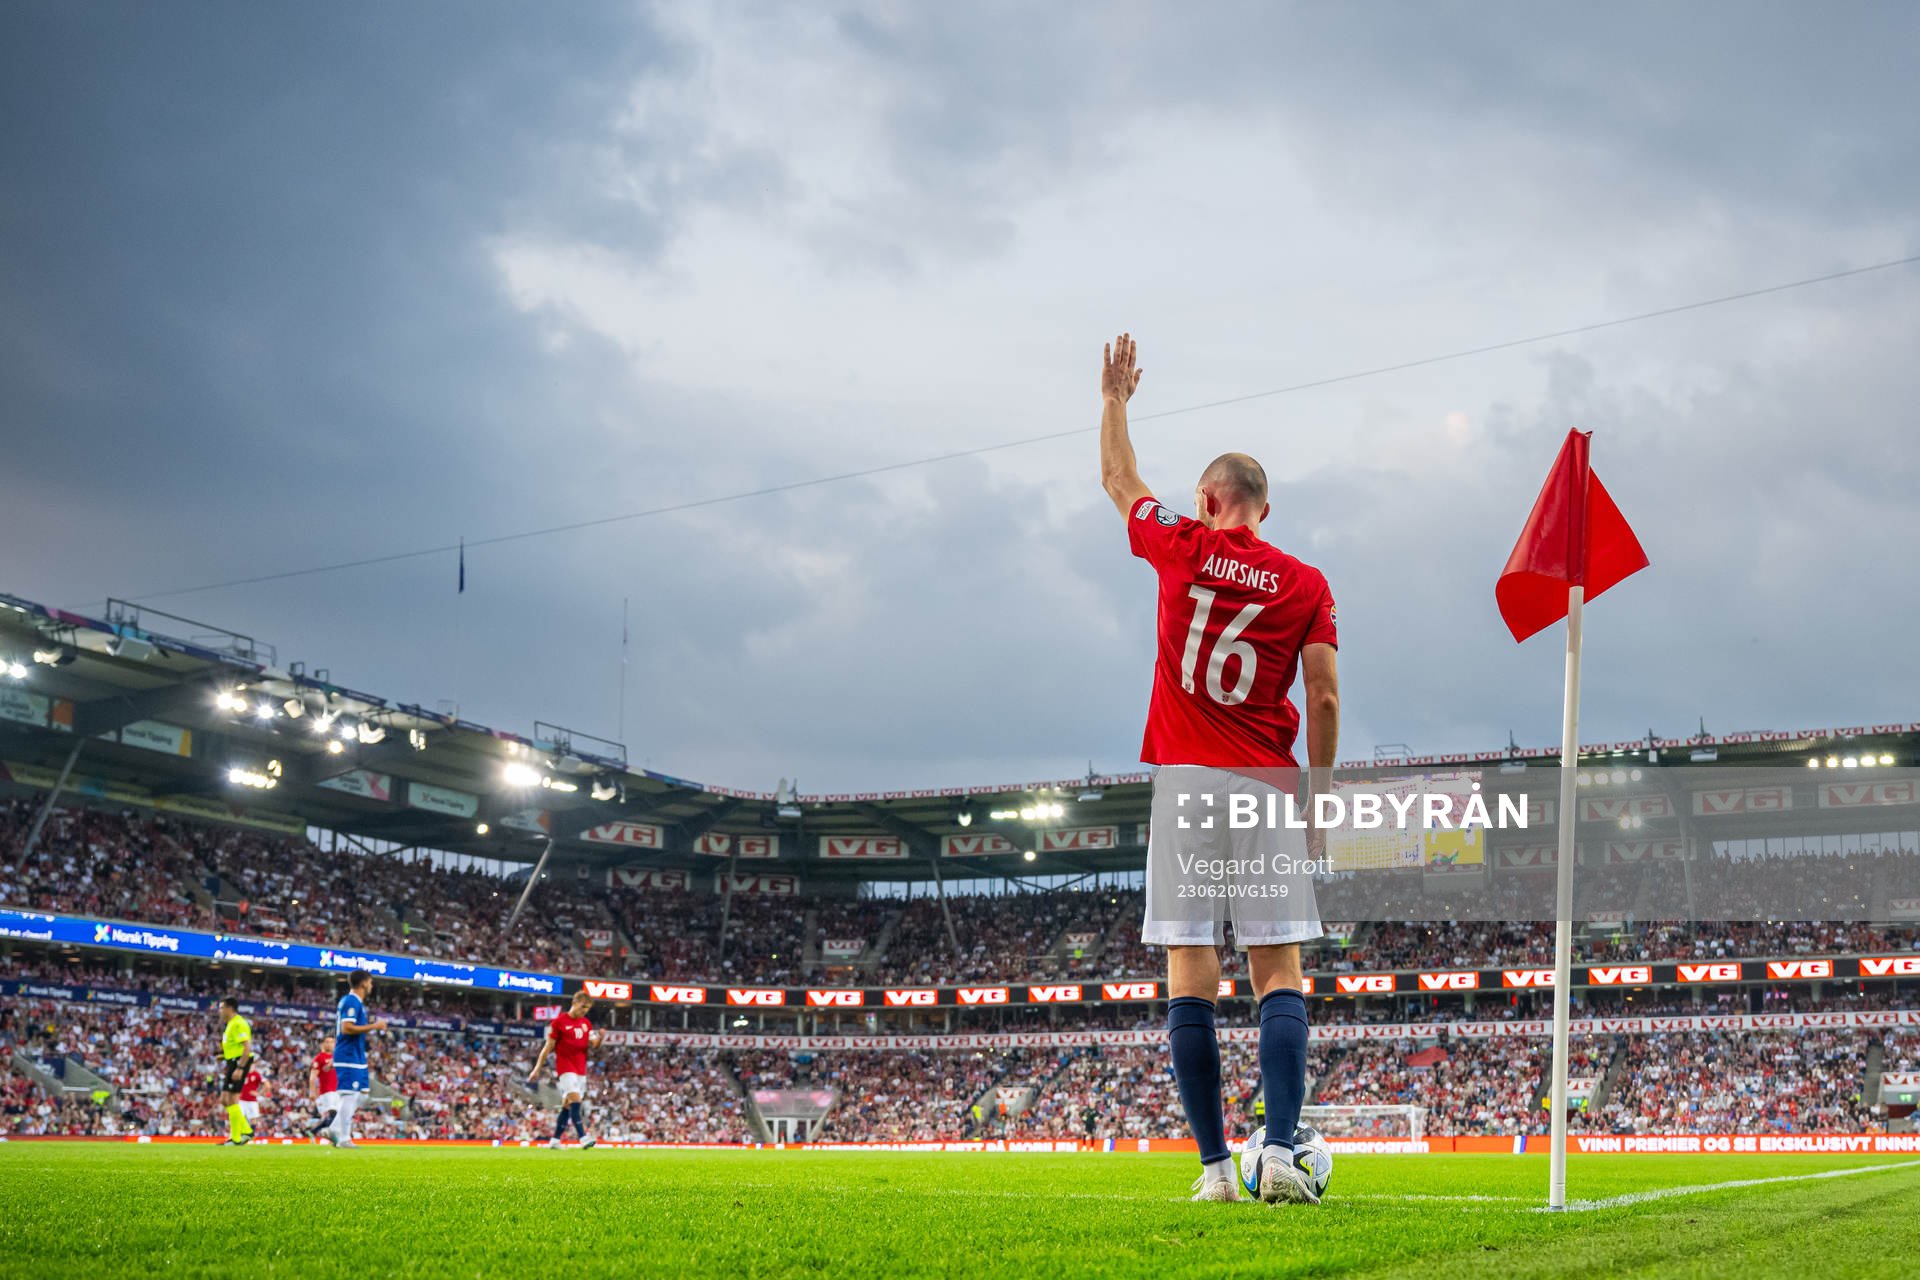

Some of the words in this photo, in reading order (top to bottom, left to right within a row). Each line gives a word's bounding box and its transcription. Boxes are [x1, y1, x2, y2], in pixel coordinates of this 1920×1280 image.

[1202, 554, 1280, 594] AURSNES
[1181, 584, 1266, 706] 16
[1797, 729, 1826, 738] VG
[1834, 727, 1864, 736] VG
[1872, 725, 1902, 734] VG
[1686, 737, 1715, 745] VG
[1723, 735, 1751, 743] VG
[1760, 732, 1788, 741] VG
[1579, 744, 1607, 752] VG
[1615, 741, 1642, 749] VG
[1441, 754, 1467, 762] VG
[1475, 752, 1502, 760] VG
[1512, 749, 1537, 757] VG
[1407, 757, 1433, 765] VG
[1829, 781, 1914, 805] VG
[1702, 790, 1784, 812] VG
[1588, 797, 1669, 820] VG
[592, 824, 655, 846] VG
[1044, 829, 1112, 849] VG
[705, 835, 769, 856] VG
[830, 838, 900, 856] VG
[950, 836, 1012, 854] VG
[1607, 841, 1684, 861] VG
[615, 868, 684, 889] VG
[723, 876, 792, 894] VG
[112, 929, 142, 945] Norsk
[143, 932, 179, 951] Tipping
[1768, 961, 1829, 978] VG
[1860, 958, 1920, 975] VG
[1590, 967, 1648, 984] VG
[1678, 964, 1738, 981] VG
[1338, 976, 1392, 992] VG
[1420, 974, 1475, 989] VG
[1504, 970, 1556, 987] VG
[584, 981, 630, 998] VG
[652, 986, 704, 1003] VG
[1030, 985, 1079, 1001] VG
[1104, 983, 1155, 999] VG
[729, 989, 782, 1005] VG
[808, 991, 861, 1005] VG
[886, 990, 935, 1005] VG
[959, 988, 1007, 1004] VG
[1651, 1019, 1692, 1029] VG
[1701, 1017, 1743, 1028] VG
[1752, 1015, 1794, 1027] VG
[1803, 1014, 1845, 1025] VG
[1856, 1013, 1899, 1024] VG
[1364, 1026, 1402, 1036] VG
[1457, 1024, 1496, 1035] VG
[1504, 1023, 1544, 1033] VG
[1602, 1020, 1642, 1031] VG
[1101, 1032, 1134, 1042] VG
[1318, 1027, 1356, 1037] VG
[633, 1034, 666, 1044] VG
[679, 1034, 711, 1045] VG
[719, 1036, 756, 1046] VG
[764, 1037, 801, 1047] VG
[809, 1038, 845, 1047] VG
[853, 1038, 889, 1047] VG
[896, 1038, 930, 1047] VG
[937, 1037, 970, 1046] VG
[977, 1036, 1011, 1046] VG
[1017, 1035, 1051, 1045] VG
[1059, 1034, 1093, 1043] VG
[1578, 1138, 1621, 1151] VINN
[1624, 1138, 1700, 1151] PREMIER
[1704, 1137, 1731, 1151] OG
[1733, 1137, 1757, 1151] SE
[1760, 1137, 1872, 1151] EKSKLUSIVT
